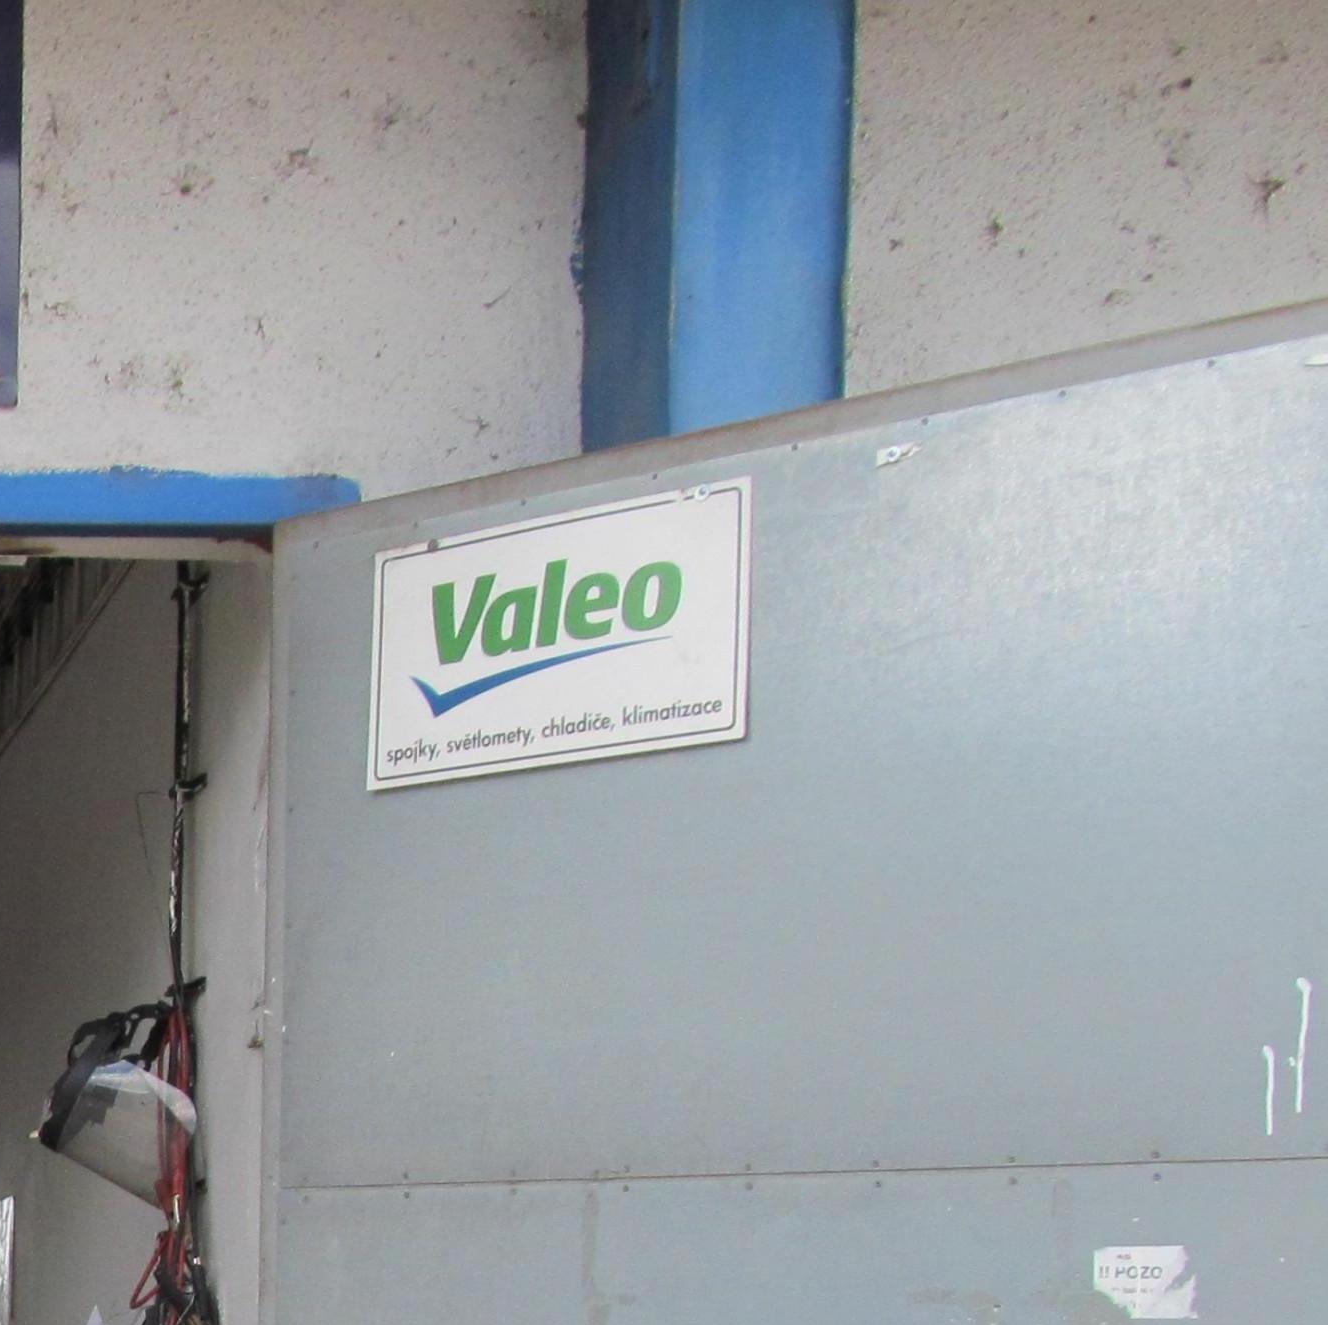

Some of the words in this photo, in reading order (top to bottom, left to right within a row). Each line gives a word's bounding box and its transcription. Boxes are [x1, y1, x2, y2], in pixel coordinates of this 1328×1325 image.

[432, 558, 684, 666] Valeo
[386, 737, 440, 768] spojky,
[446, 727, 536, 755] světlomety,
[541, 712, 616, 740] chladiče,
[621, 699, 723, 727] klimatizace
